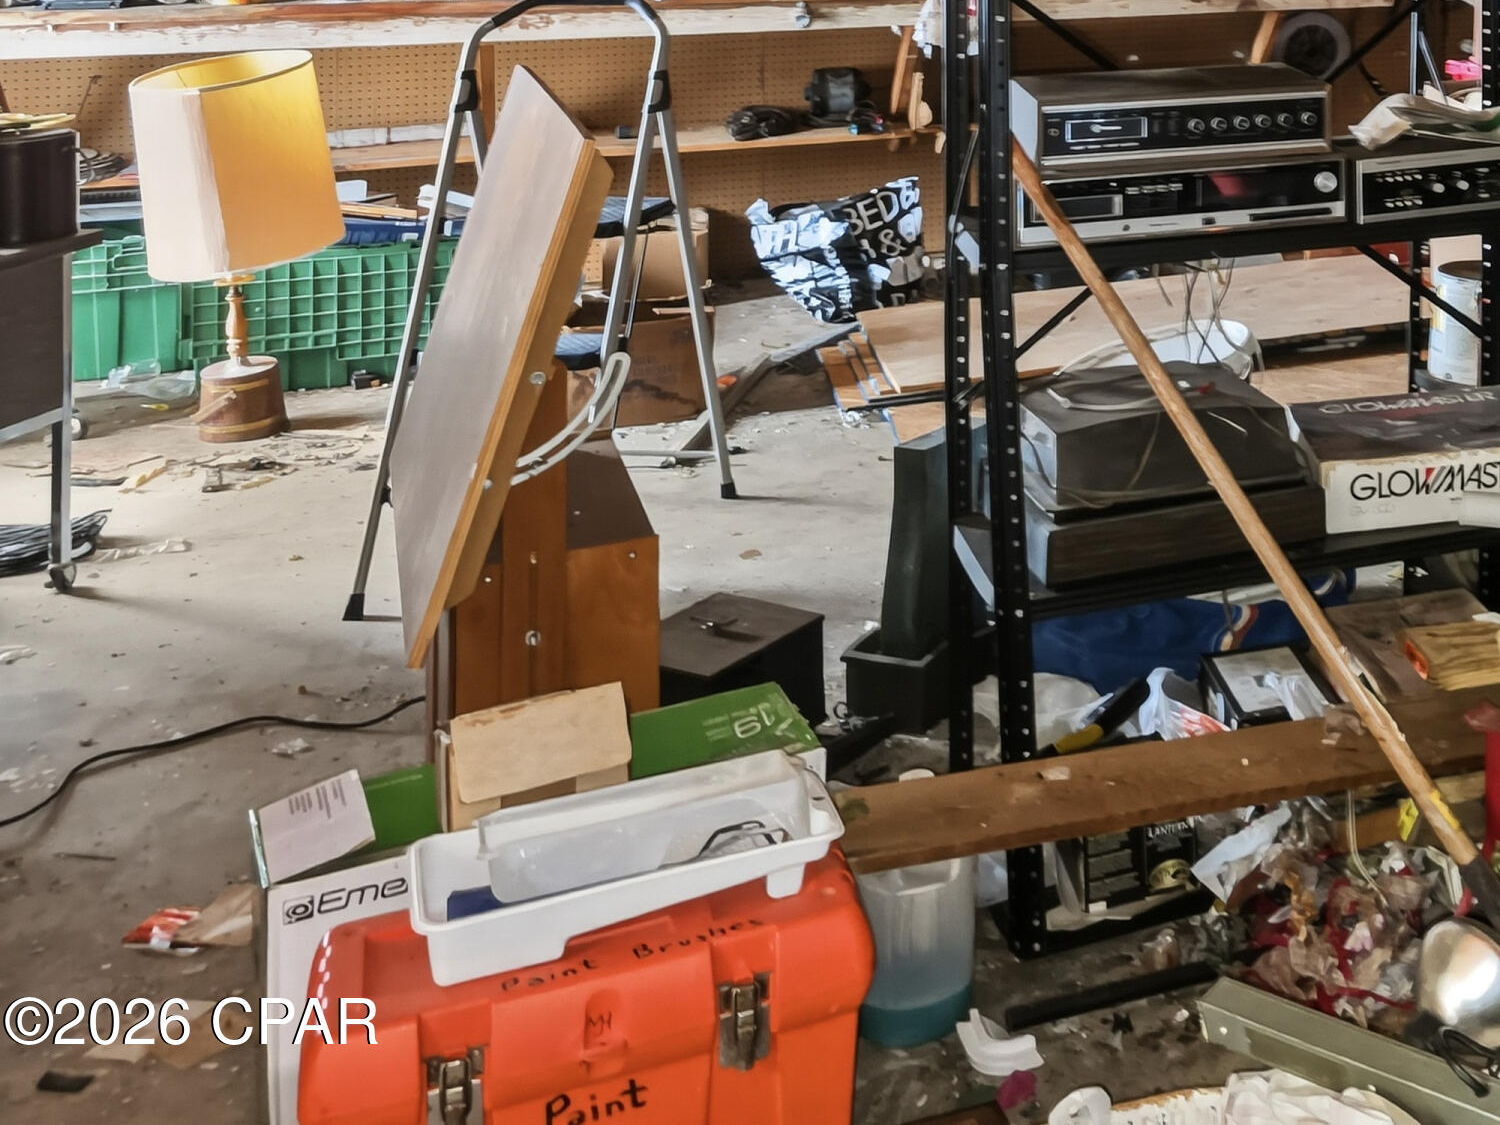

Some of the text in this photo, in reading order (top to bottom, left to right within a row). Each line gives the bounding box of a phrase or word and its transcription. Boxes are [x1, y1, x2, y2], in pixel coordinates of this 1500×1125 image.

[501, 920, 765, 992] Paint Brushes
[545, 1078, 648, 1125] Paint
